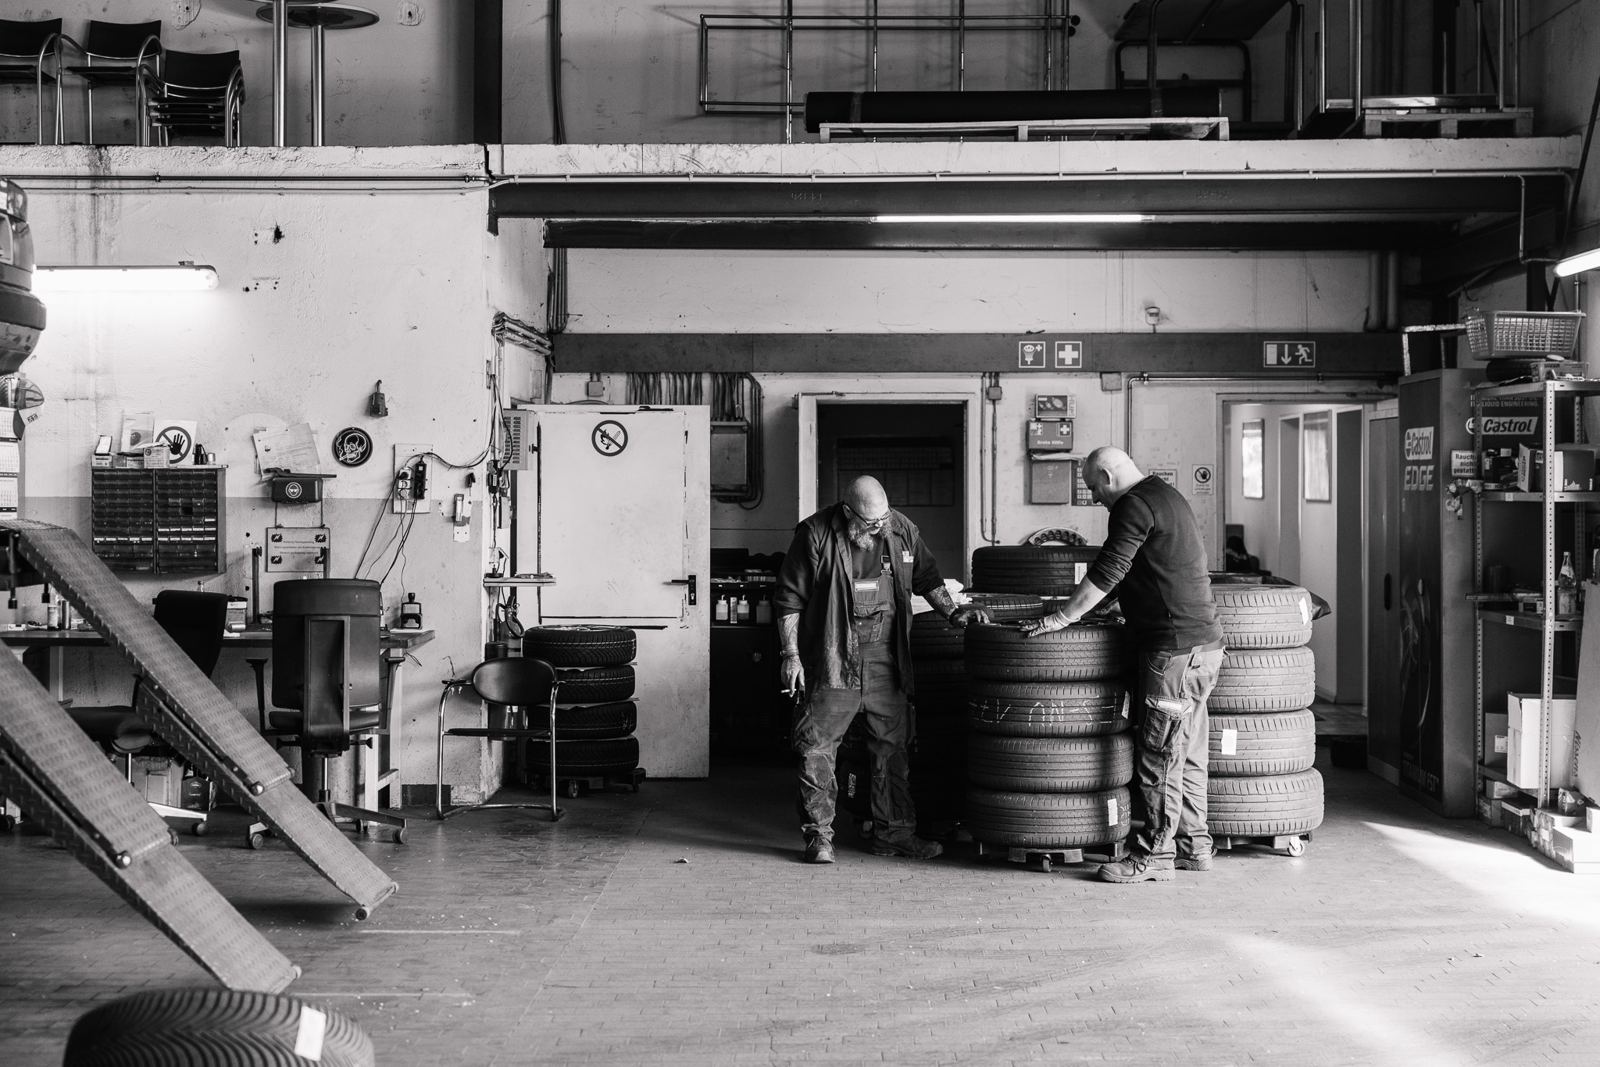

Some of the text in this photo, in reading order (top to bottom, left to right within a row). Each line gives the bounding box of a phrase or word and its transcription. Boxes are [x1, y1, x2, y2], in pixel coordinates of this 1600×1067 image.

[1484, 418, 1533, 433] Castrol
[1411, 431, 1432, 456] Castrol
[1404, 465, 1434, 491] EDGE
